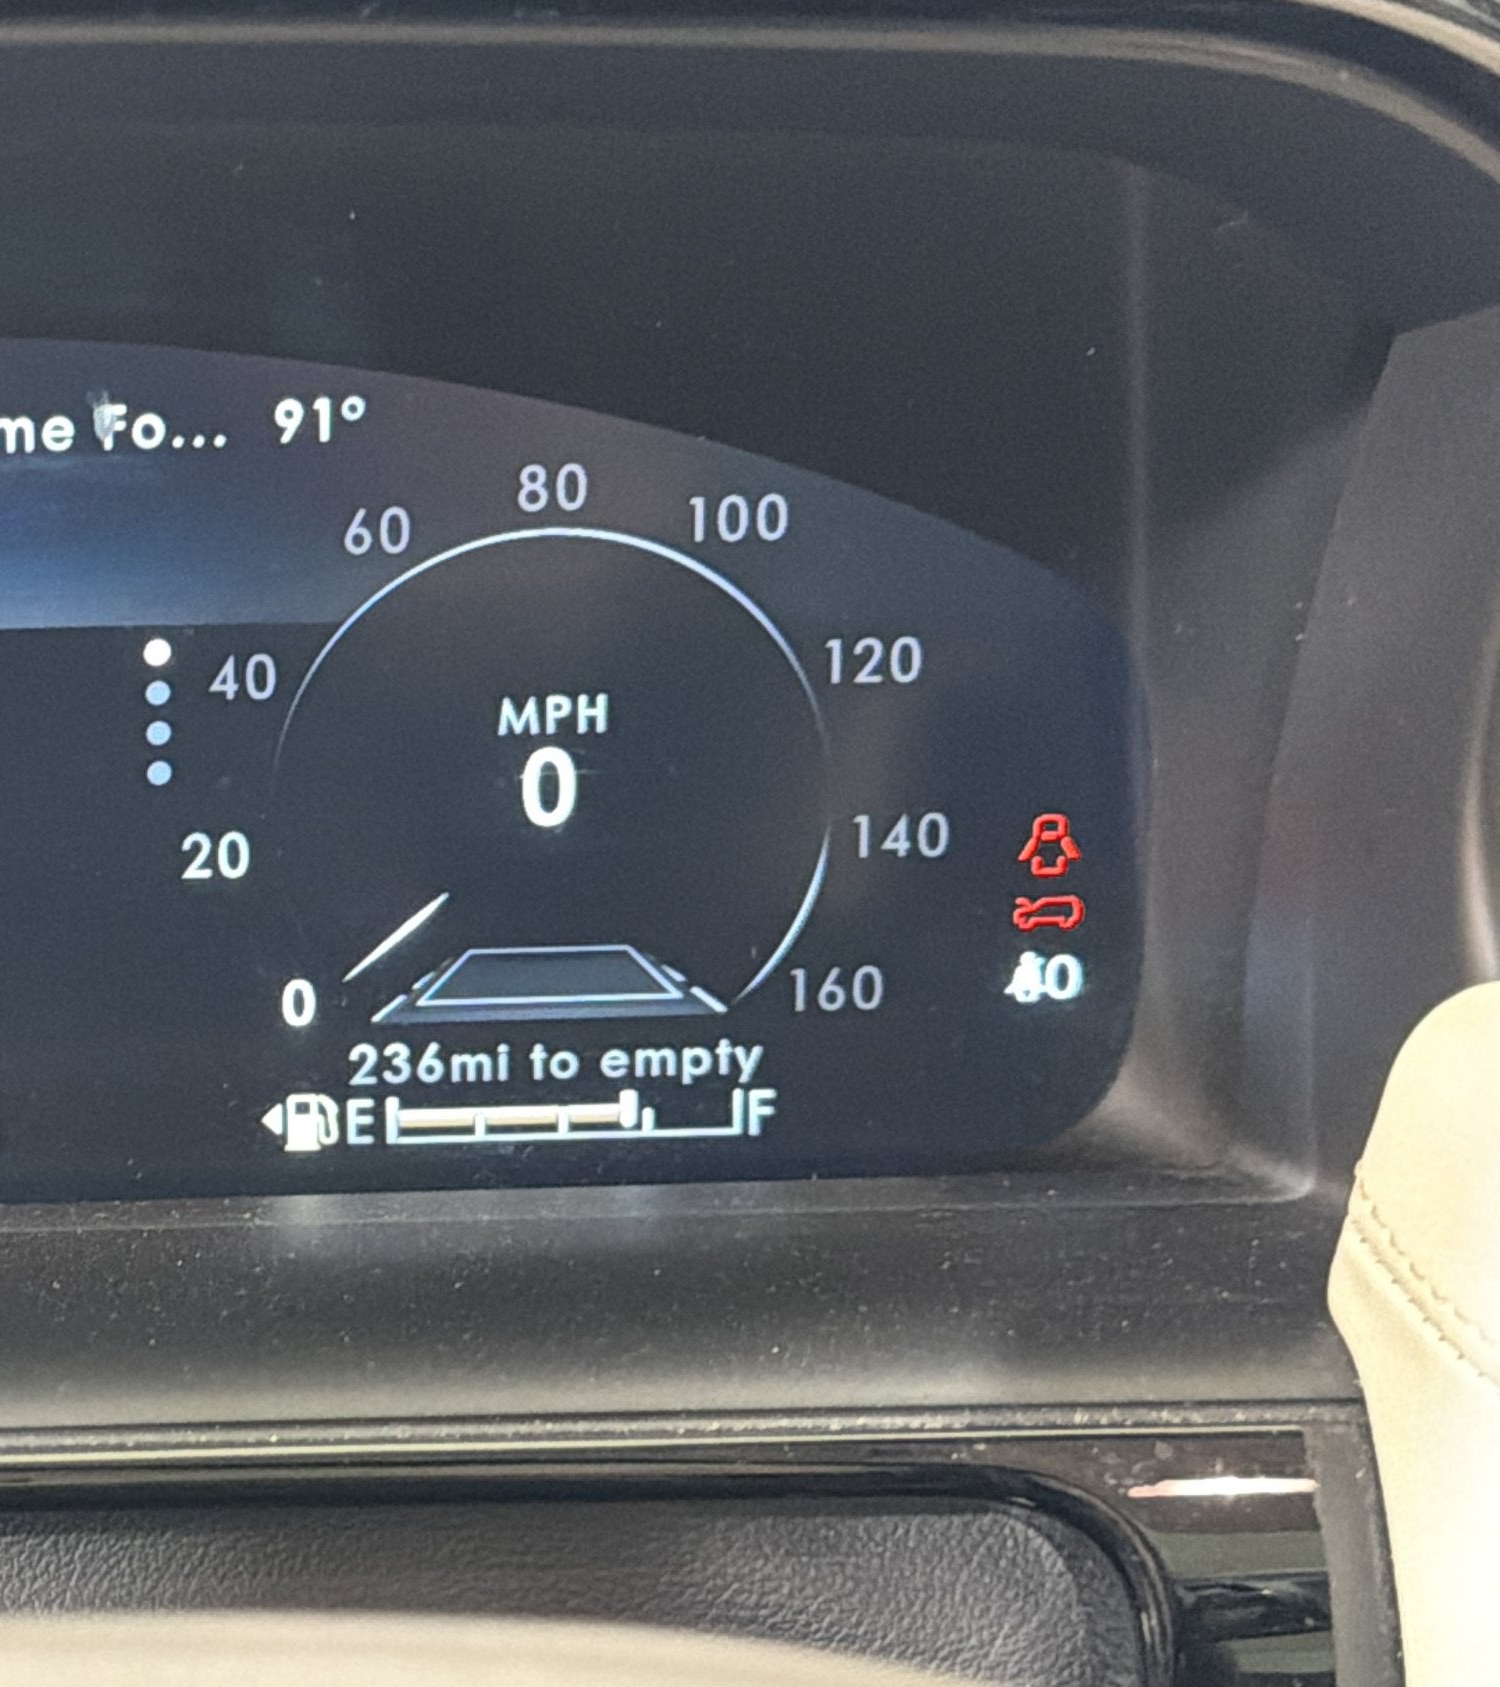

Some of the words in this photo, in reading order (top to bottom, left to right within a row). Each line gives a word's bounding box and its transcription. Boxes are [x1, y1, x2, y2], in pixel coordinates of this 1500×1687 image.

[517, 462, 588, 513] 80
[344, 506, 411, 556] 60
[689, 493, 788, 543] 100
[209, 653, 277, 701] 40
[825, 636, 922, 684] 120
[497, 693, 608, 737] MPH
[519, 745, 578, 828] 0
[181, 830, 250, 880] 20
[853, 812, 949, 858] 140
[281, 978, 317, 1028] 0
[790, 965, 884, 1012] 160
[348, 1041, 510, 1086] 236mi
[529, 1043, 580, 1081] to
[600, 1038, 764, 1085] empty
[346, 1097, 375, 1145] E
[747, 1088, 777, 1137] F
